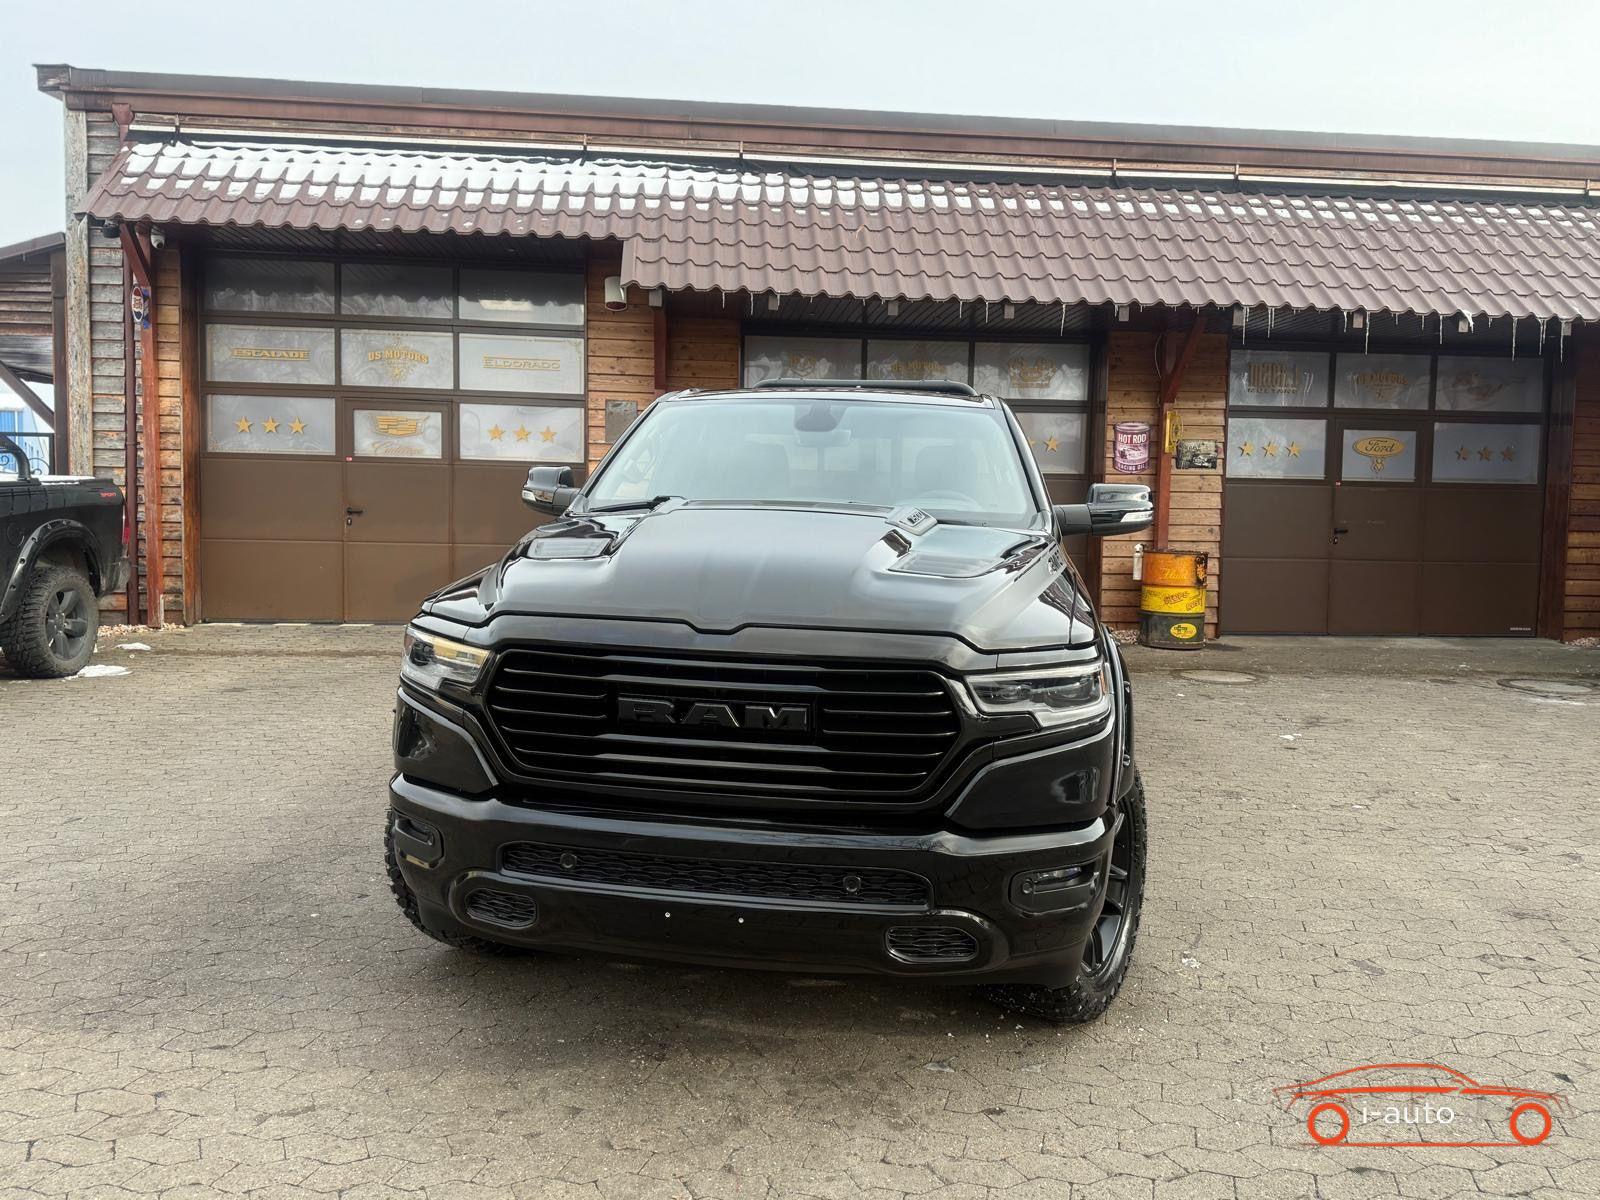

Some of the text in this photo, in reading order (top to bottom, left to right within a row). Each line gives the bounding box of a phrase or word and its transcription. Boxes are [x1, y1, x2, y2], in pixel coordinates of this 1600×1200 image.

[368, 351, 381, 361] US
[1118, 433, 1147, 444] HOT ROD
[1365, 439, 1395, 452] Ford
[618, 696, 808, 731] RAM
